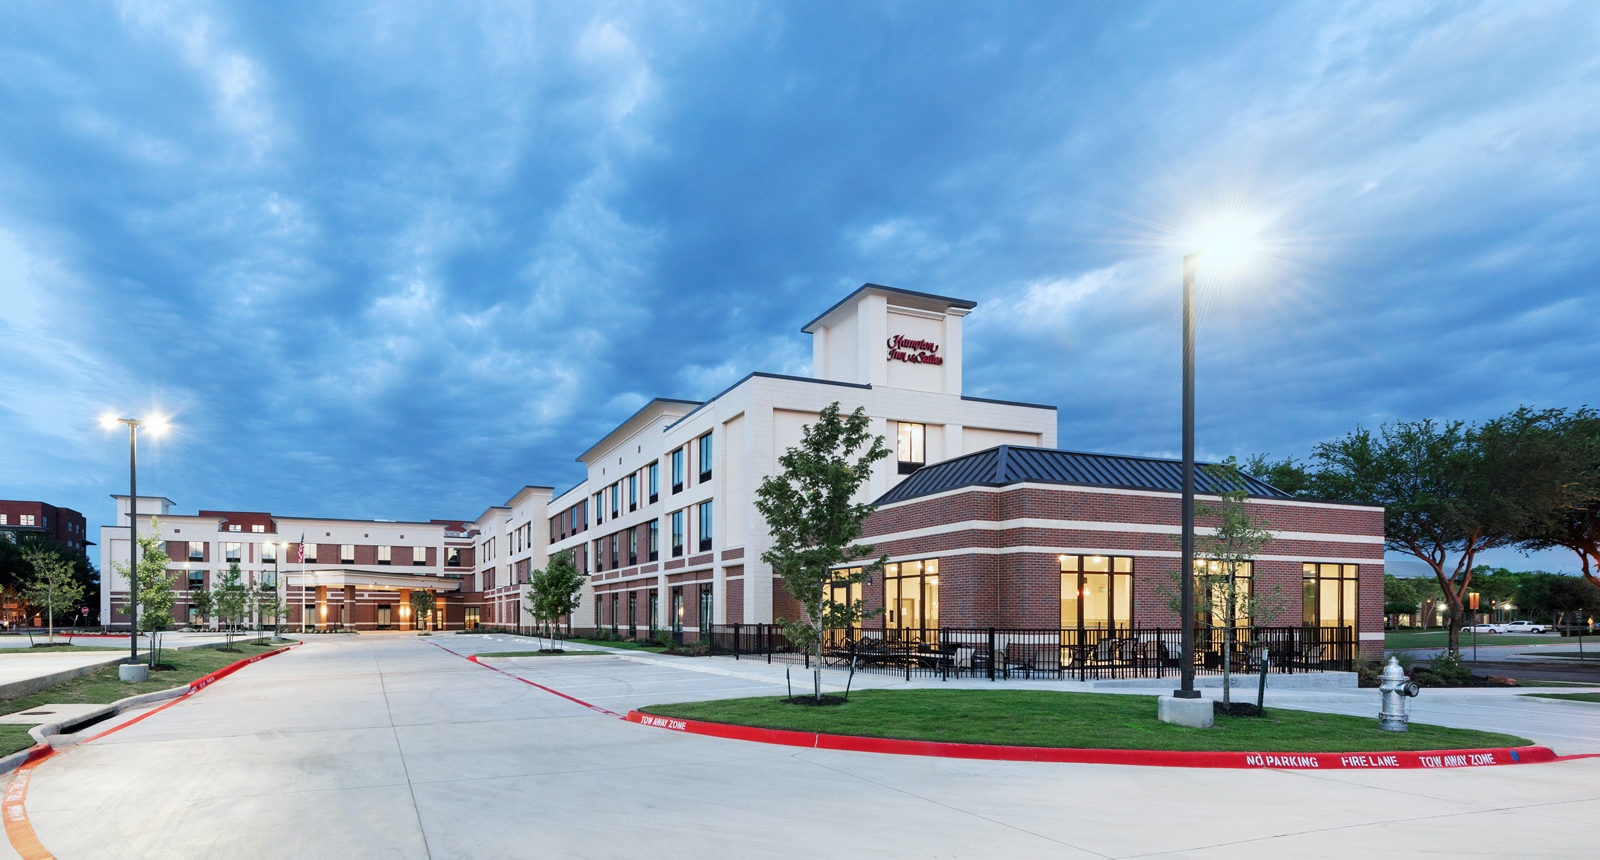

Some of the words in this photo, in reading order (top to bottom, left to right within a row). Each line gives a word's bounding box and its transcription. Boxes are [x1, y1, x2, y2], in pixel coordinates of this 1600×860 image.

[887, 334, 939, 353] Hampton
[887, 349, 909, 363] Inn
[917, 351, 943, 365] Suites
[641, 715, 654, 725] TOW
[652, 717, 668, 727] AWAY
[668, 719, 687, 731] ZONE
[1246, 755, 1264, 766] NO
[1265, 755, 1319, 767] PARKING
[1341, 755, 1369, 767] FIRE
[1368, 755, 1400, 767] LANE
[1418, 756, 1442, 768] TOW
[1443, 754, 1468, 767] AWAY
[1468, 753, 1496, 766] ZONE
